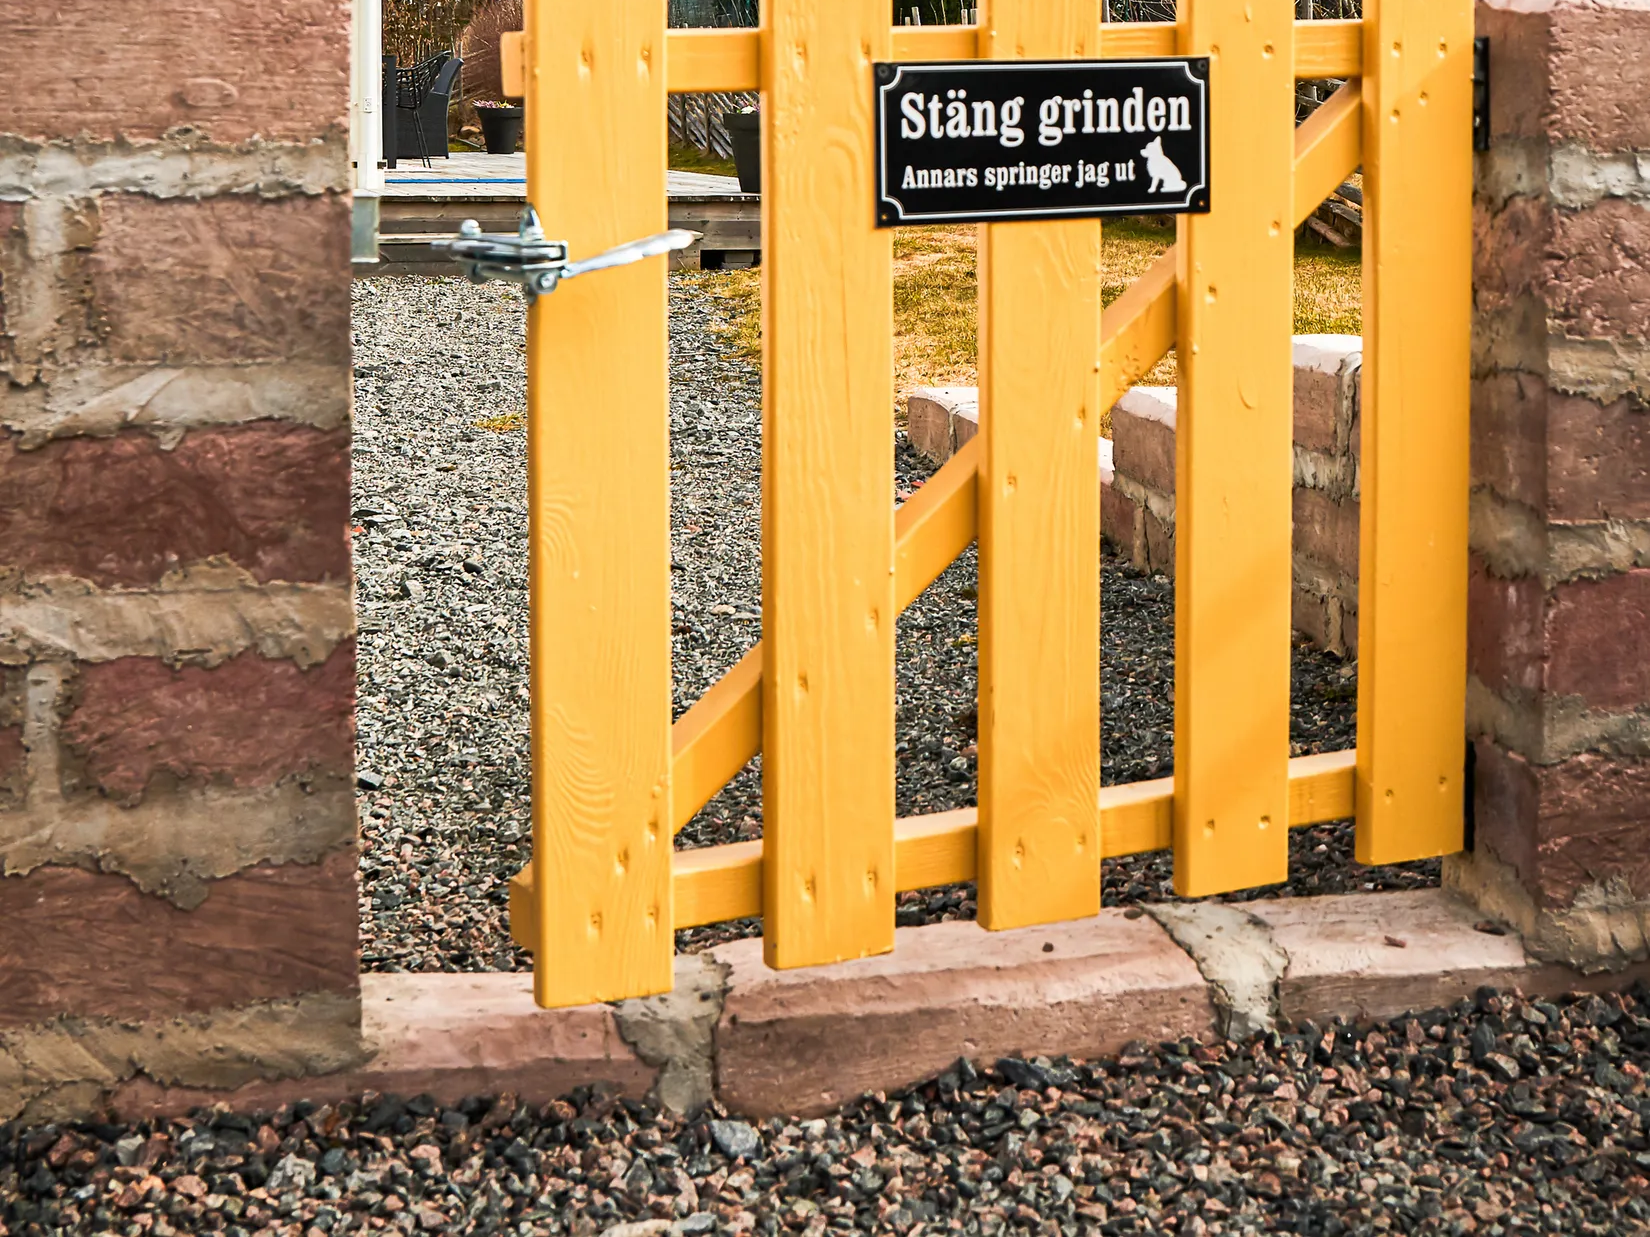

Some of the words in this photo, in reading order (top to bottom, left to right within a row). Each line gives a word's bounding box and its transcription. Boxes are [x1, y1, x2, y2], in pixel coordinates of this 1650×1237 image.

[900, 89, 1025, 147] Stäng
[1038, 87, 1192, 147] grinden
[901, 165, 978, 190] Annars
[984, 161, 1073, 192] springer
[1075, 160, 1110, 189] jag
[1114, 159, 1136, 182] ut
